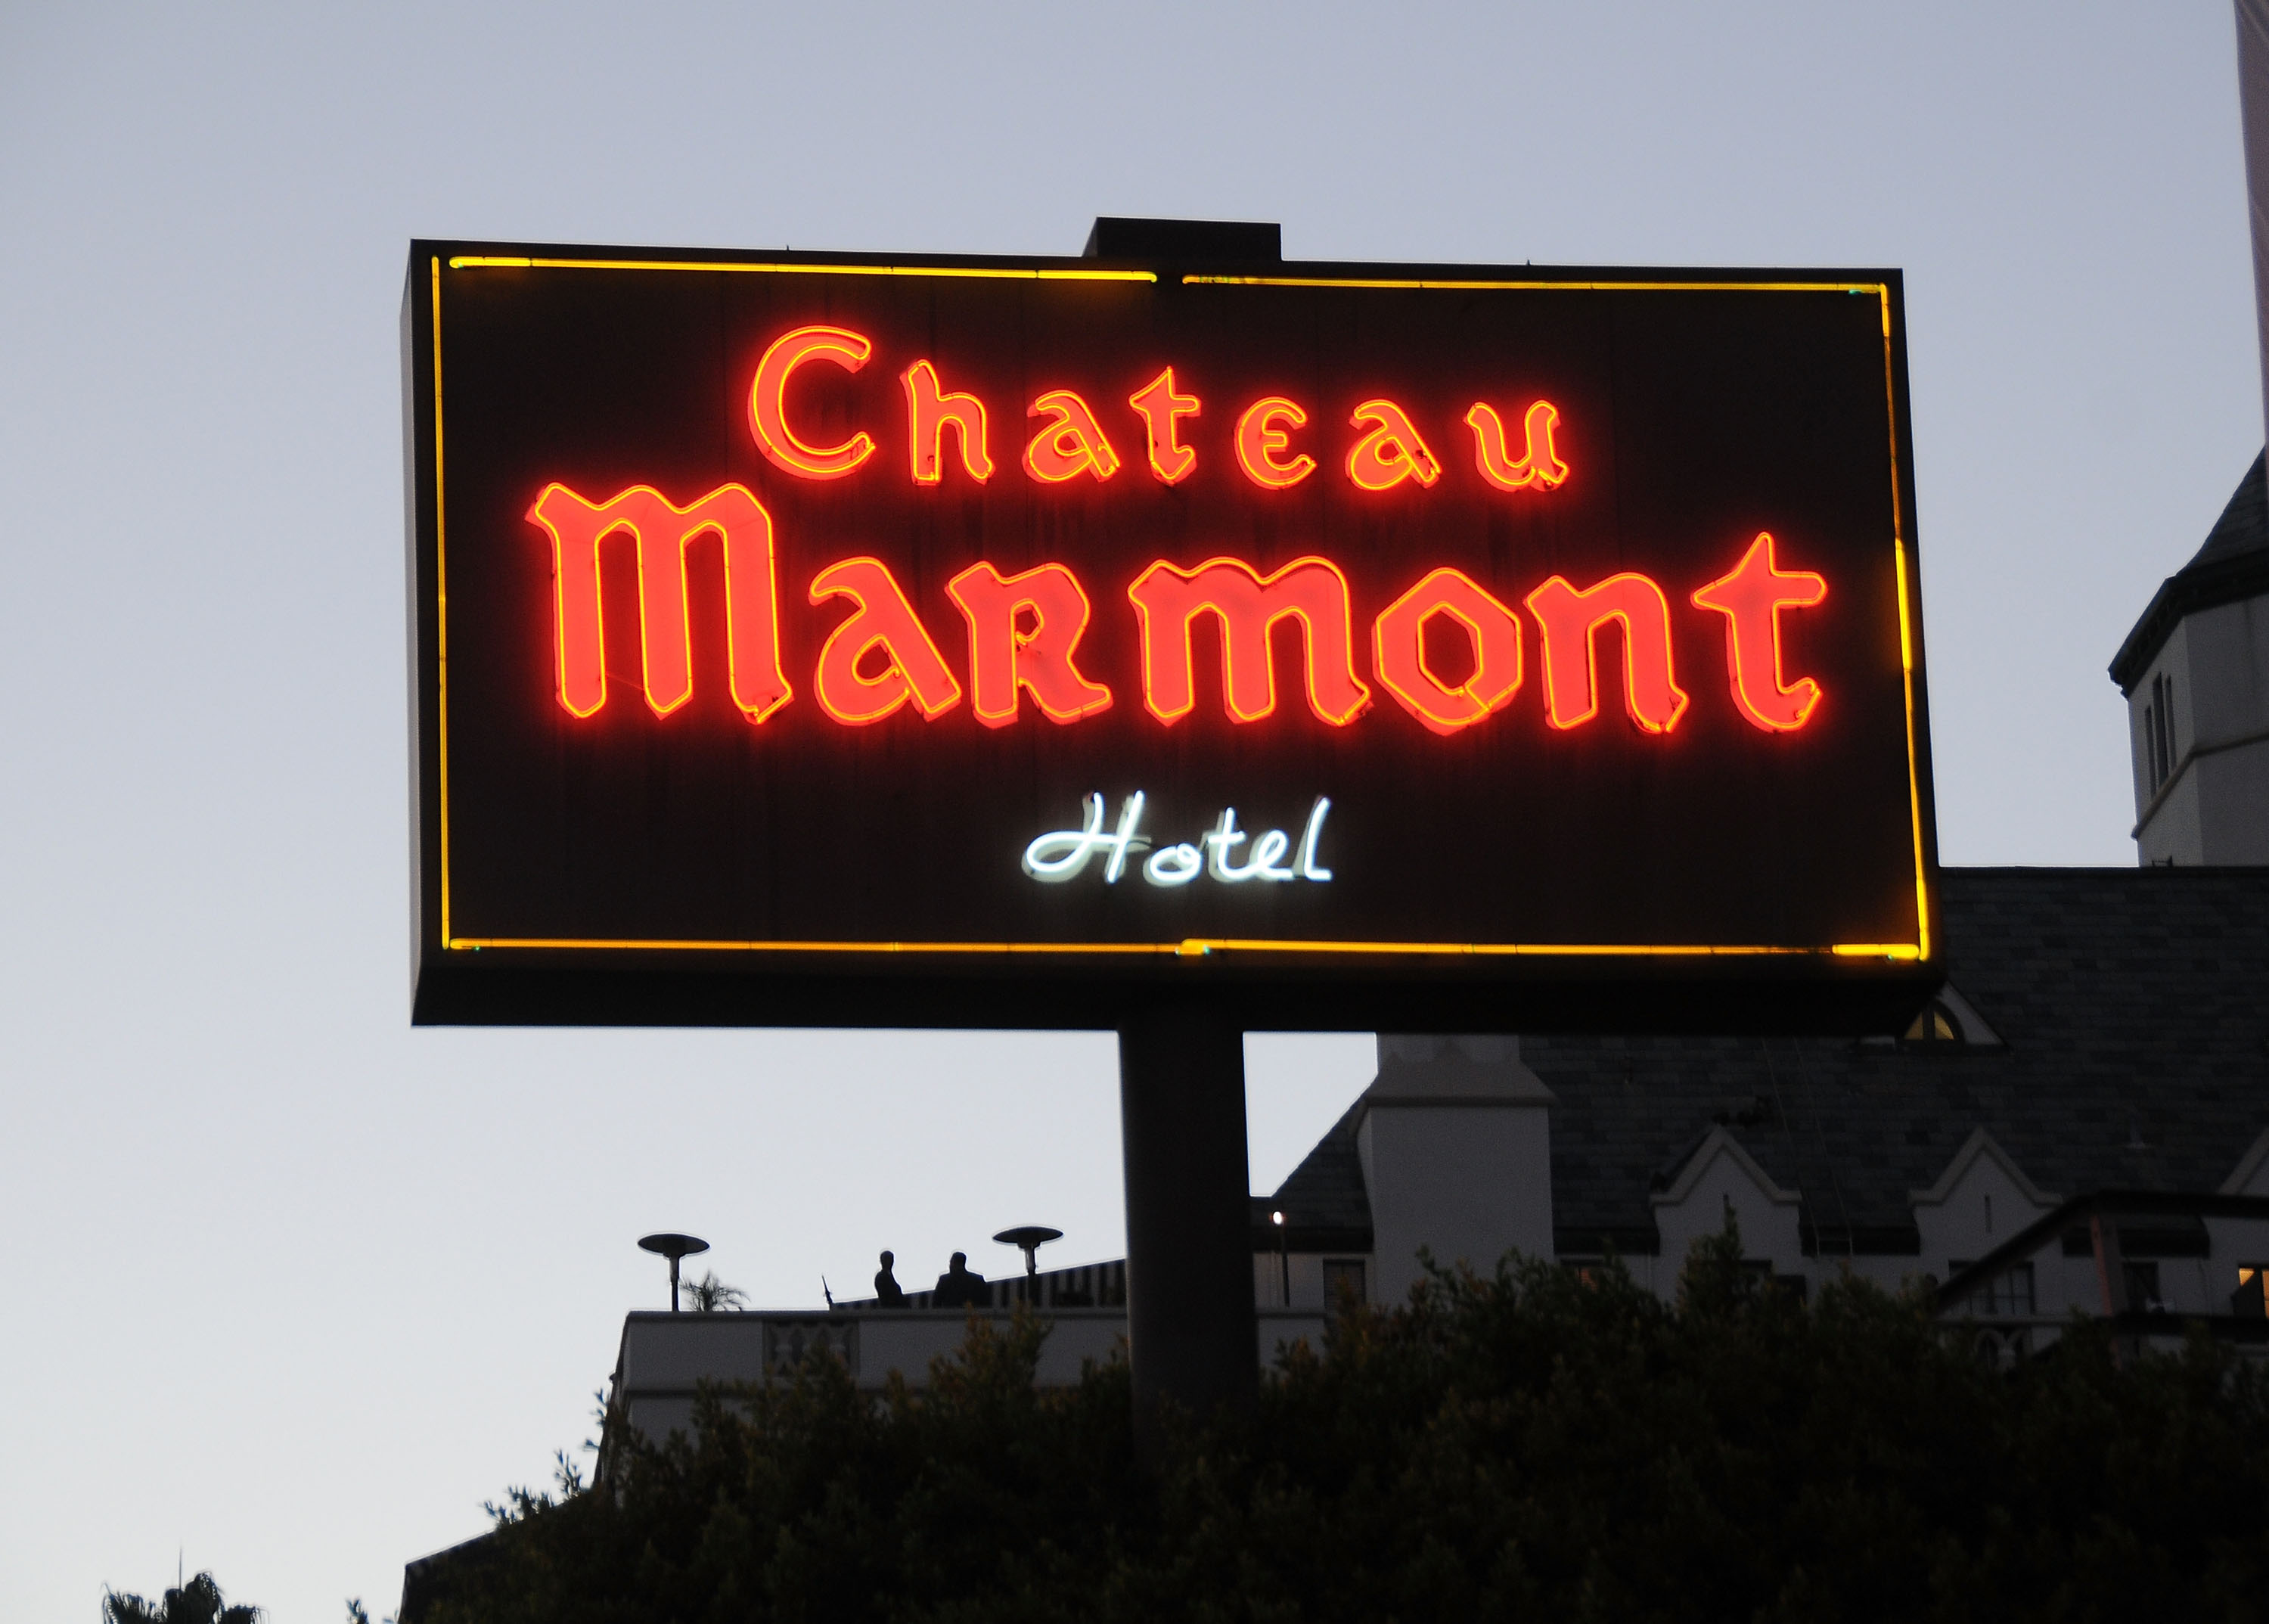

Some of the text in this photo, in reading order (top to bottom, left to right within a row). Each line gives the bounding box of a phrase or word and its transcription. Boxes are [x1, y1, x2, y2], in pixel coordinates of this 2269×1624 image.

[747, 323, 1572, 492] Chateau
[526, 480, 1828, 735] Marmont
[1022, 790, 1333, 885] Hotel
